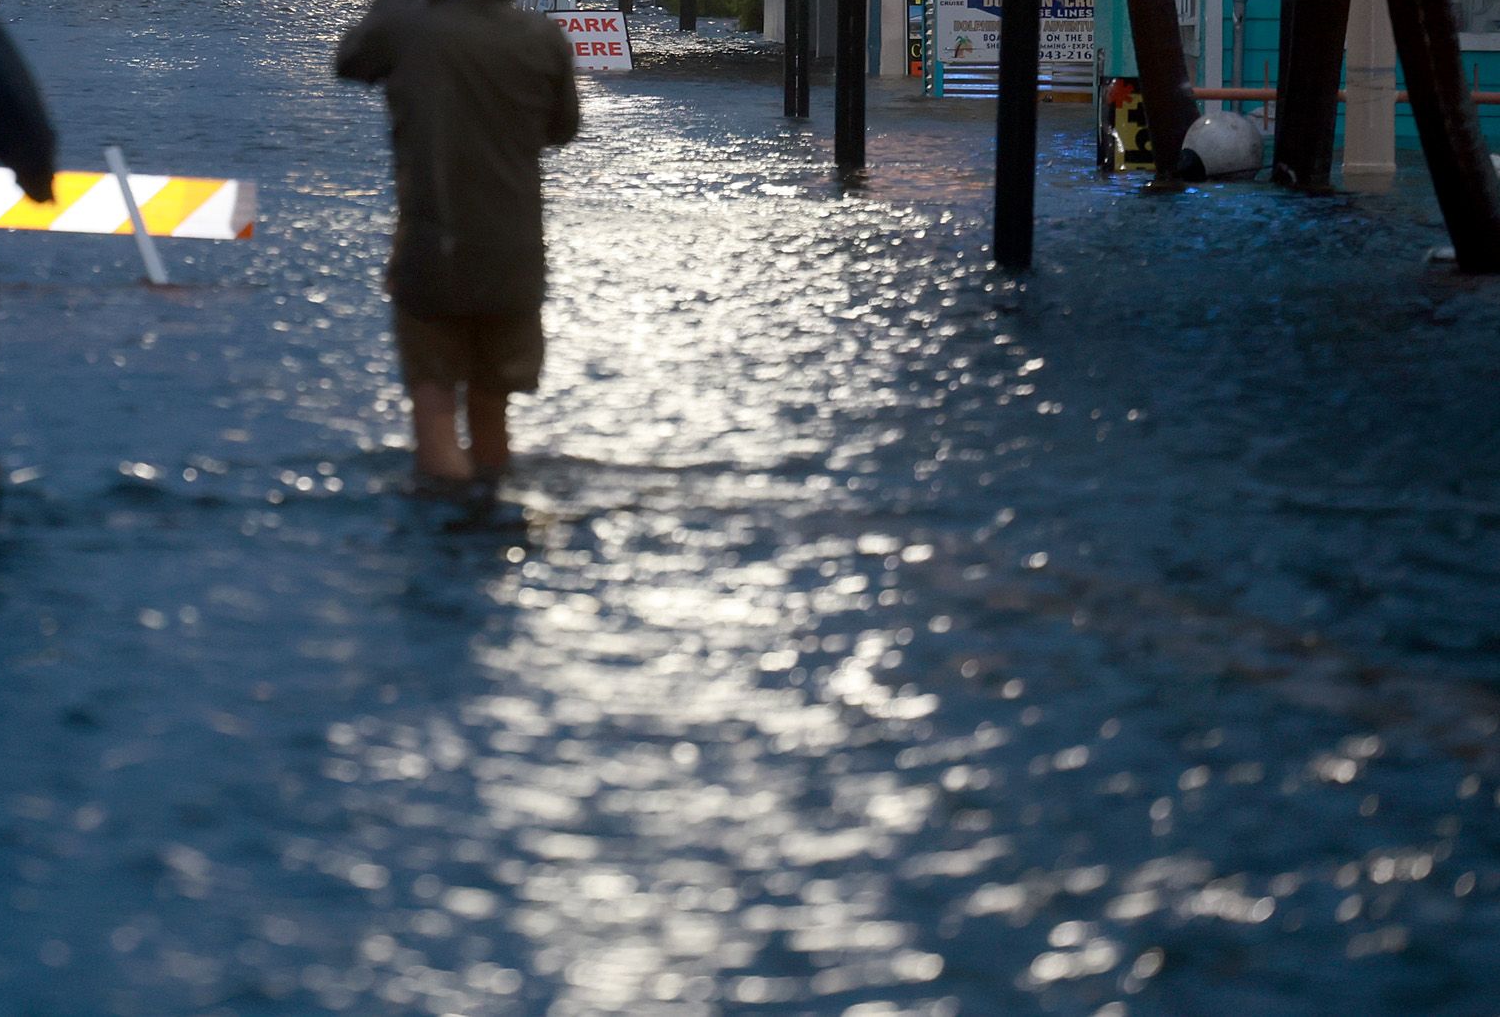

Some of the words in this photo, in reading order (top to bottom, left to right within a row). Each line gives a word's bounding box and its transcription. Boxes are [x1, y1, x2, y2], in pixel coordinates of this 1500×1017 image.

[1057, 9, 1093, 18] LINES
[554, 18, 619, 33] PARK
[1046, 33, 1060, 42] ON
[1066, 34, 1082, 42] THE
[566, 41, 623, 57] ERE
